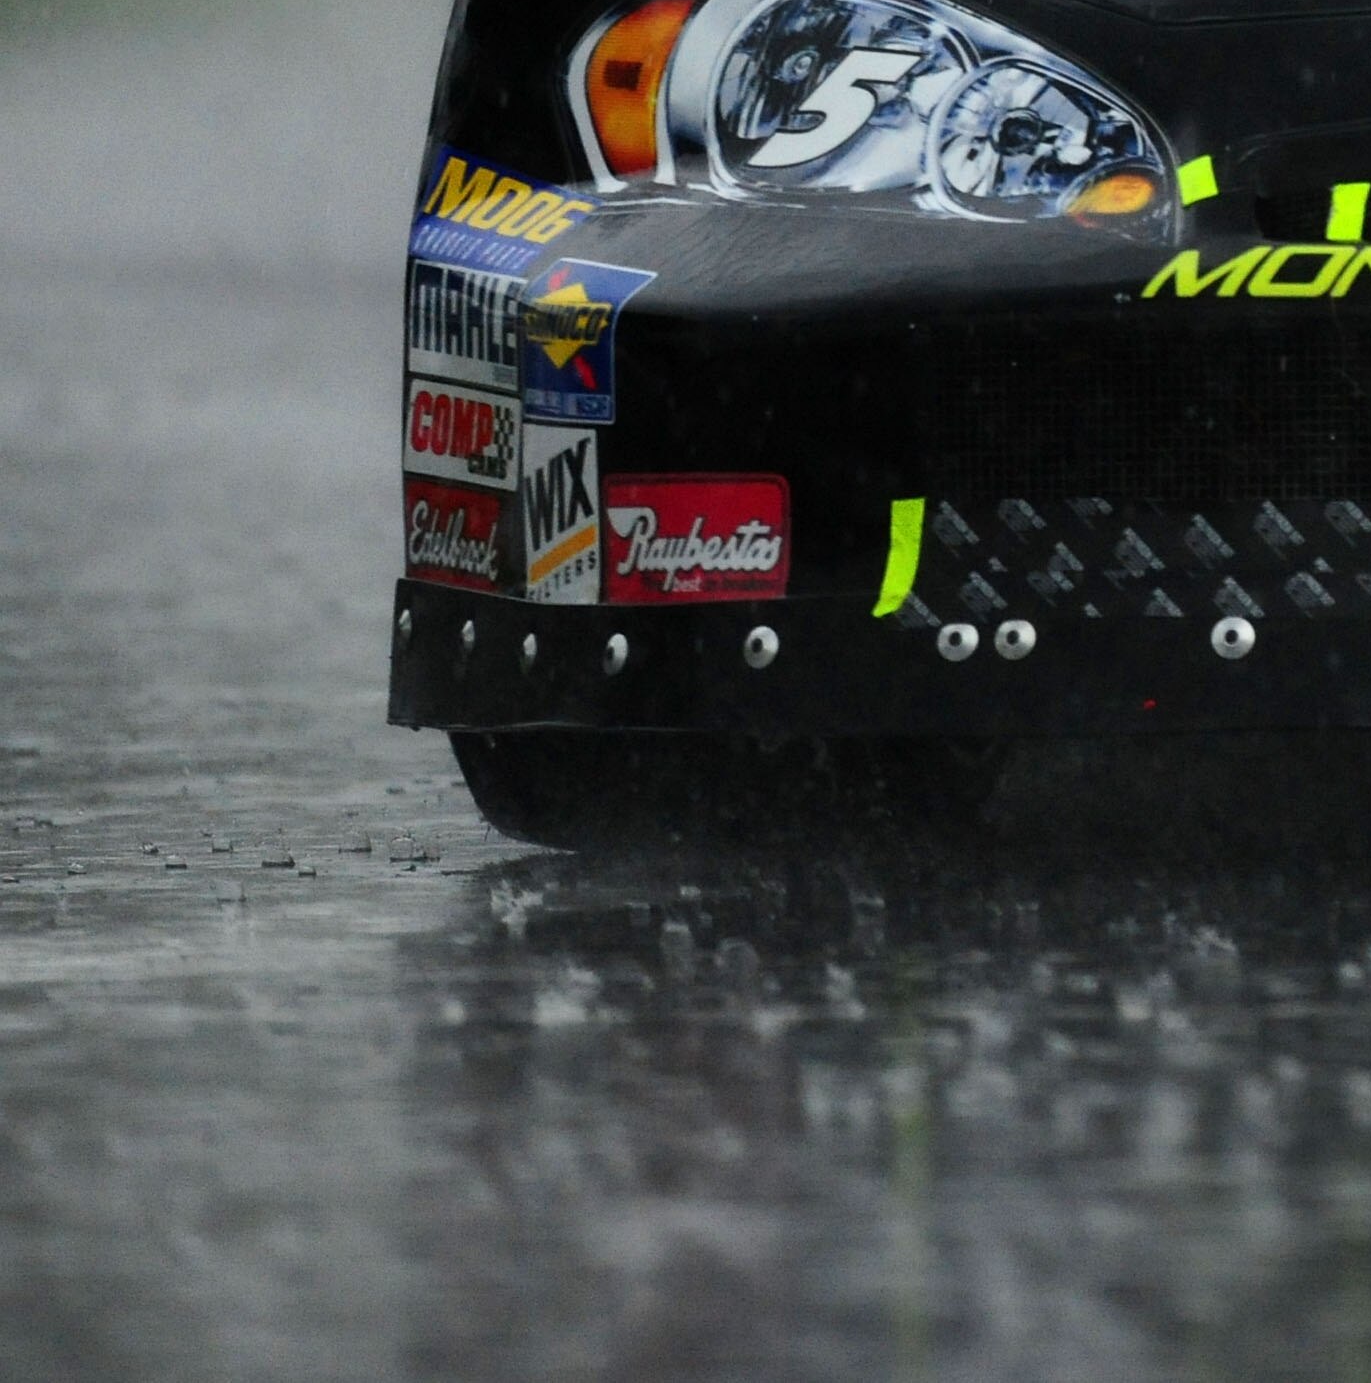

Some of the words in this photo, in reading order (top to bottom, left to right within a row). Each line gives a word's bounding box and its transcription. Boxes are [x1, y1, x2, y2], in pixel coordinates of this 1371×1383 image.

[747, 48, 922, 167] 5
[424, 156, 596, 244] MOOG
[411, 263, 526, 368] MAHLE
[410, 391, 493, 460] COMP
[524, 437, 595, 552] WIX
[408, 500, 499, 583] Edelbrock
[607, 505, 783, 592] Raybestos
